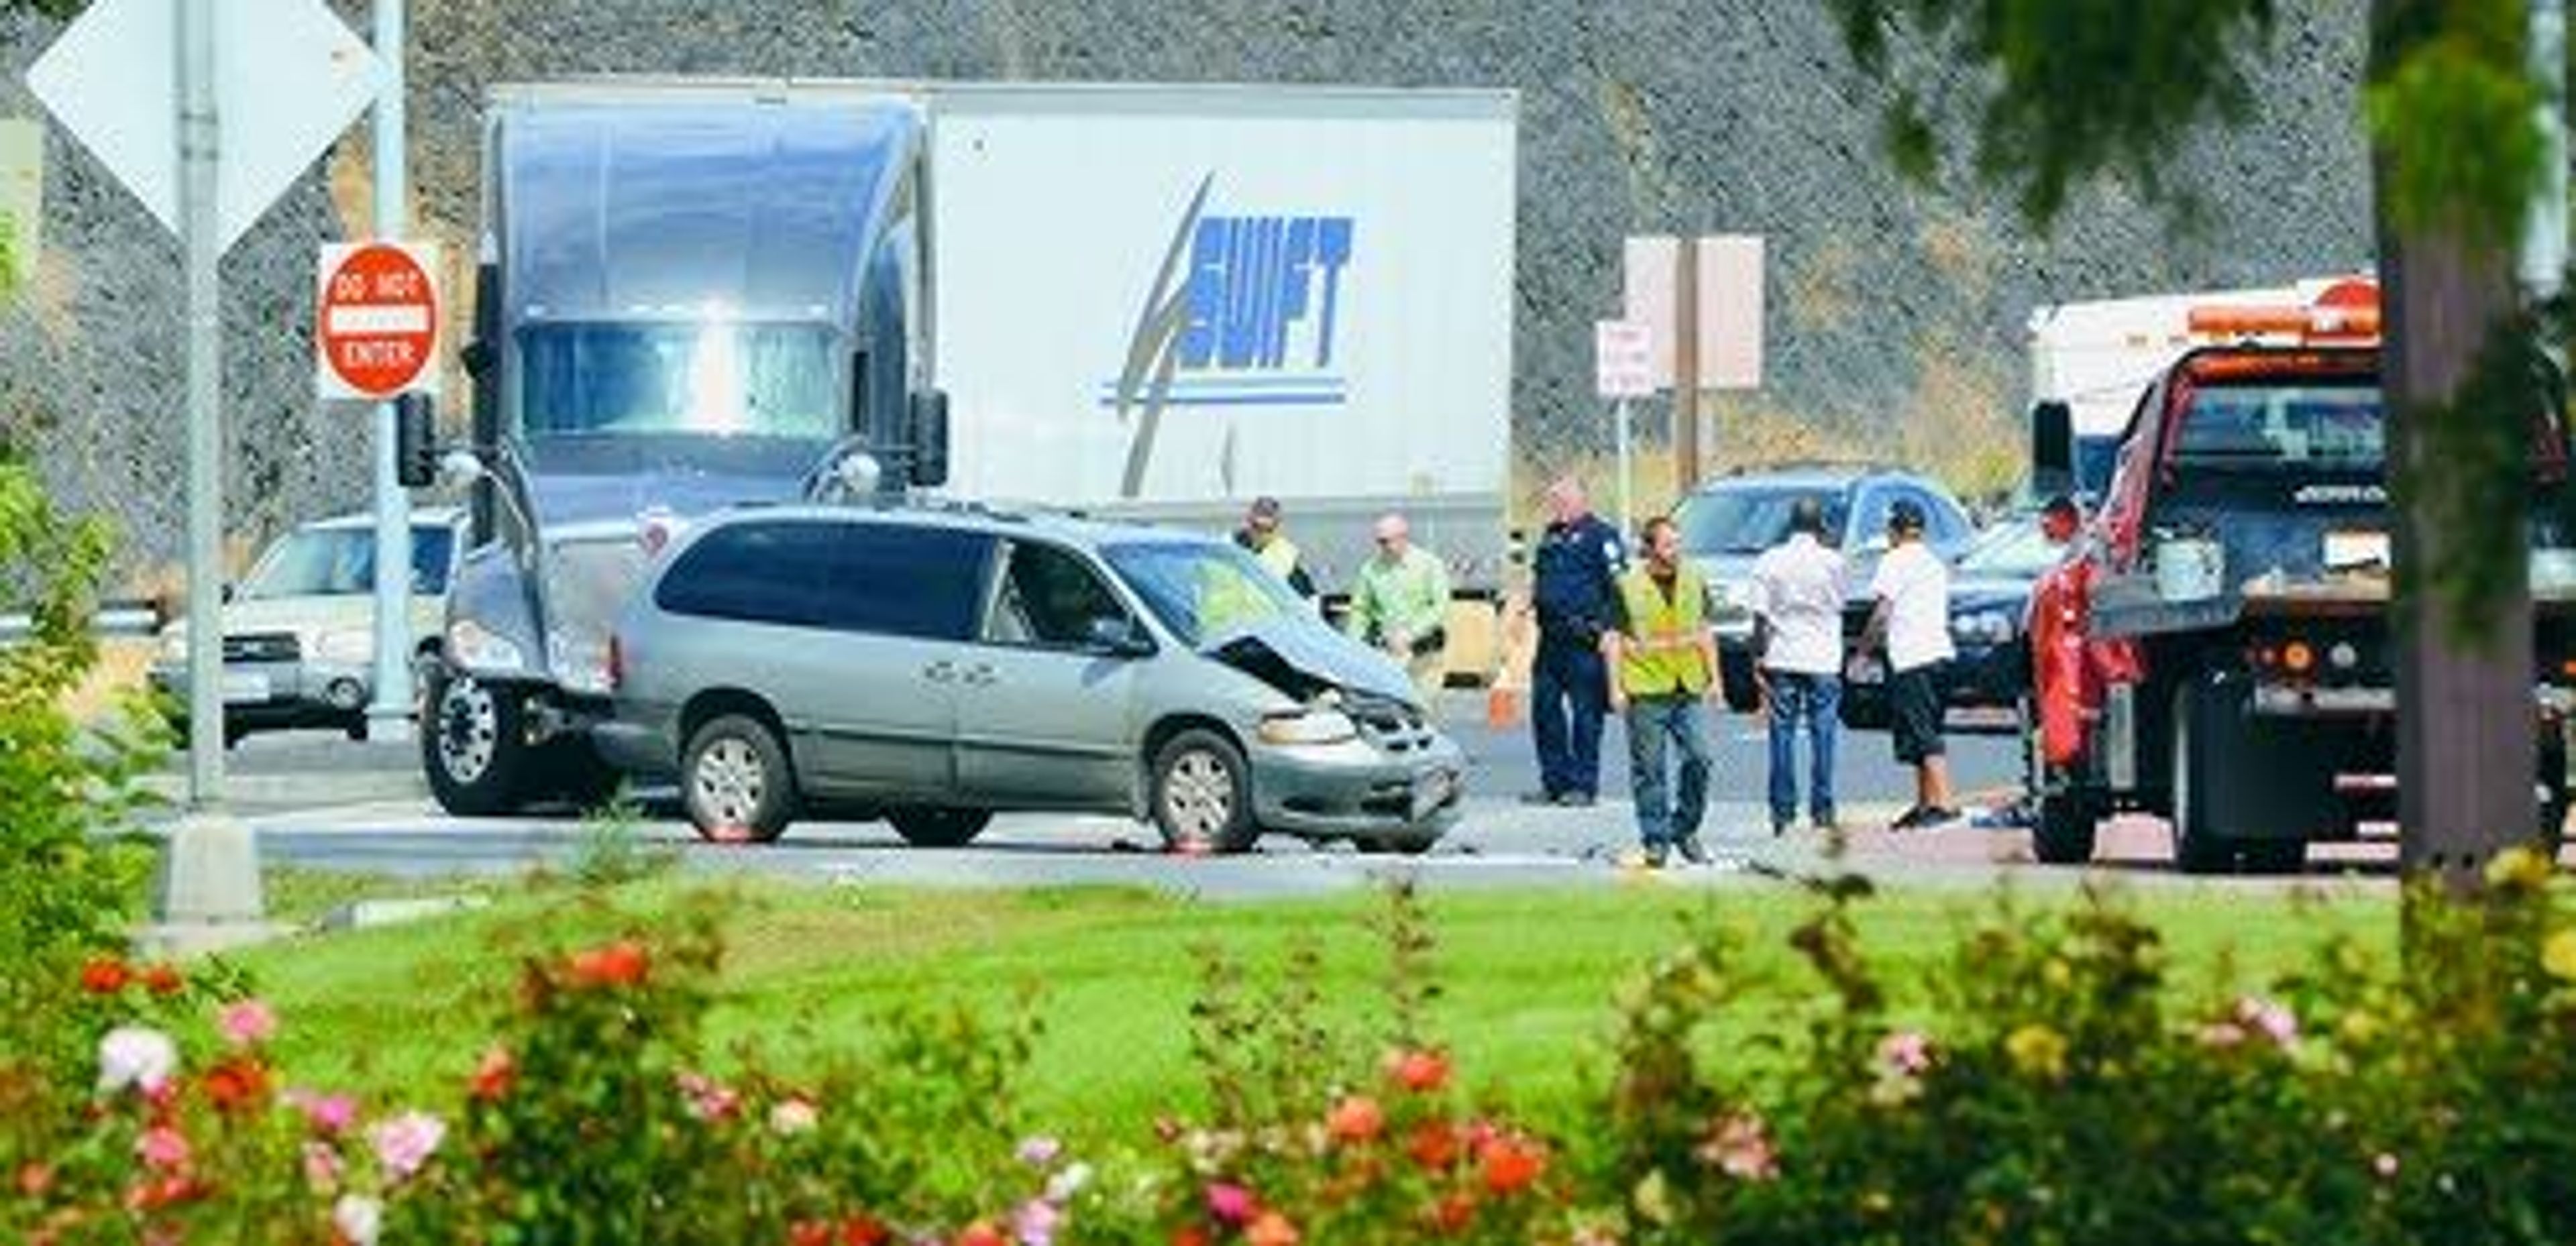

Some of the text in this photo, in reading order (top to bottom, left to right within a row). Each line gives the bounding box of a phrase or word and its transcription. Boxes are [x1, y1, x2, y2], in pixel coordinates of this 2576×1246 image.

[335, 270, 421, 301] DO NOT
[1177, 216, 1354, 368] SWIFT
[344, 341, 416, 367] ENTER
